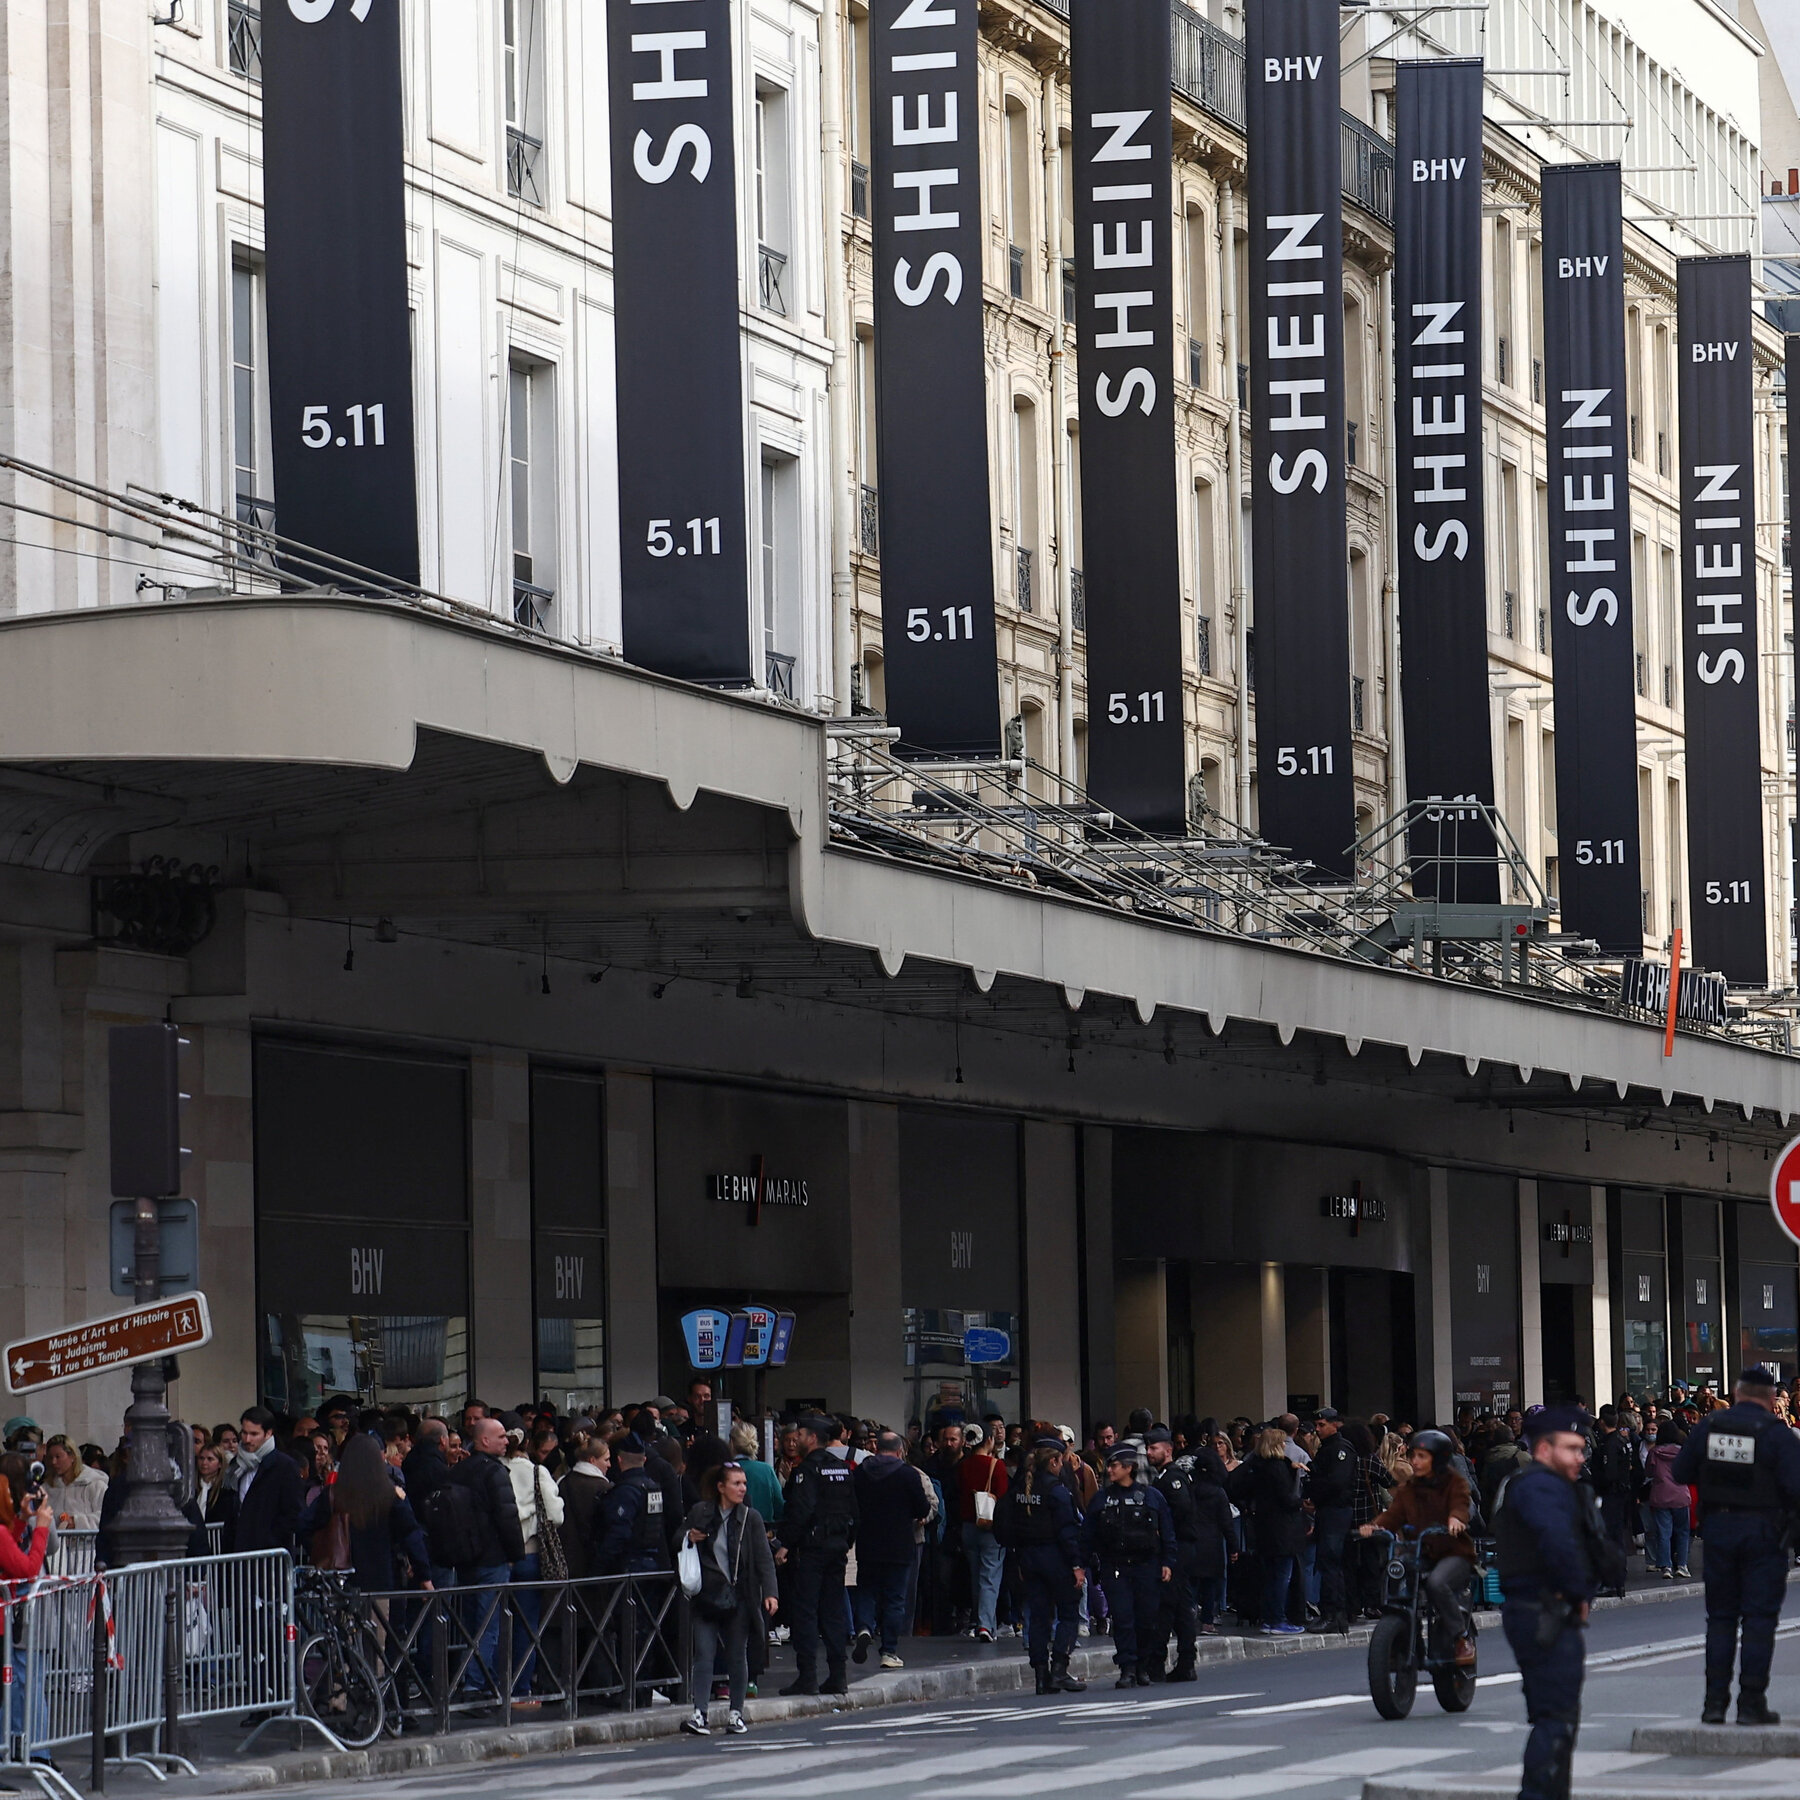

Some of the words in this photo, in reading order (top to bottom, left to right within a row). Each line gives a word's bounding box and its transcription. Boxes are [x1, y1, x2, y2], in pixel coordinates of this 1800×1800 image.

[1264, 55, 1323, 83] BHV
[630, 0, 712, 184] SH
[889, 0, 963, 307] SHEIN
[1412, 157, 1467, 182] BHV
[1090, 109, 1156, 417] SHEIN
[1558, 255, 1609, 279] BHV
[1266, 213, 1328, 495] SHEIN
[1692, 341, 1739, 363] BHV
[301, 403, 385, 449] 5.11
[1411, 301, 1469, 562] SHEIN
[1561, 388, 1619, 627] SHEIN
[646, 517, 721, 557] 5.11
[1693, 464, 1745, 685] SHEIN
[906, 605, 973, 642] 5.11
[1107, 691, 1165, 724] 5.11
[1277, 745, 1333, 776] 5.11
[1426, 793, 1478, 822] 5.11
[1575, 839, 1624, 865] 5.11
[1706, 880, 1750, 904] 5.11
[1645, 964, 1671, 1012] BH
[1680, 971, 1729, 1027] MARAIS
[733, 1175, 757, 1202] BHV
[765, 1178, 809, 1207] MARAIS
[951, 1231, 973, 1269] BHV
[351, 1247, 384, 1295] BHV
[555, 1255, 584, 1300] BHV
[1477, 1263, 1490, 1293] BHV
[48, 1334, 78, 1350] Musée
[82, 1327, 107, 1345] d'Art
[109, 1322, 120, 1334] et
[122, 1308, 170, 1331] d'Histoire
[699, 1319, 711, 1327] BUS
[753, 1313, 765, 1323] 72
[50, 1350, 62, 1364] du
[65, 1340, 108, 1360] Judaïsme
[83, 1355, 95, 1367] du
[98, 1347, 129, 1364] Temple
[745, 1344, 758, 1354] 96
[1761, 1361, 1781, 1385] EIN
[1718, 1436, 1744, 1448] CRS
[1015, 1493, 1042, 1505] POLCE
